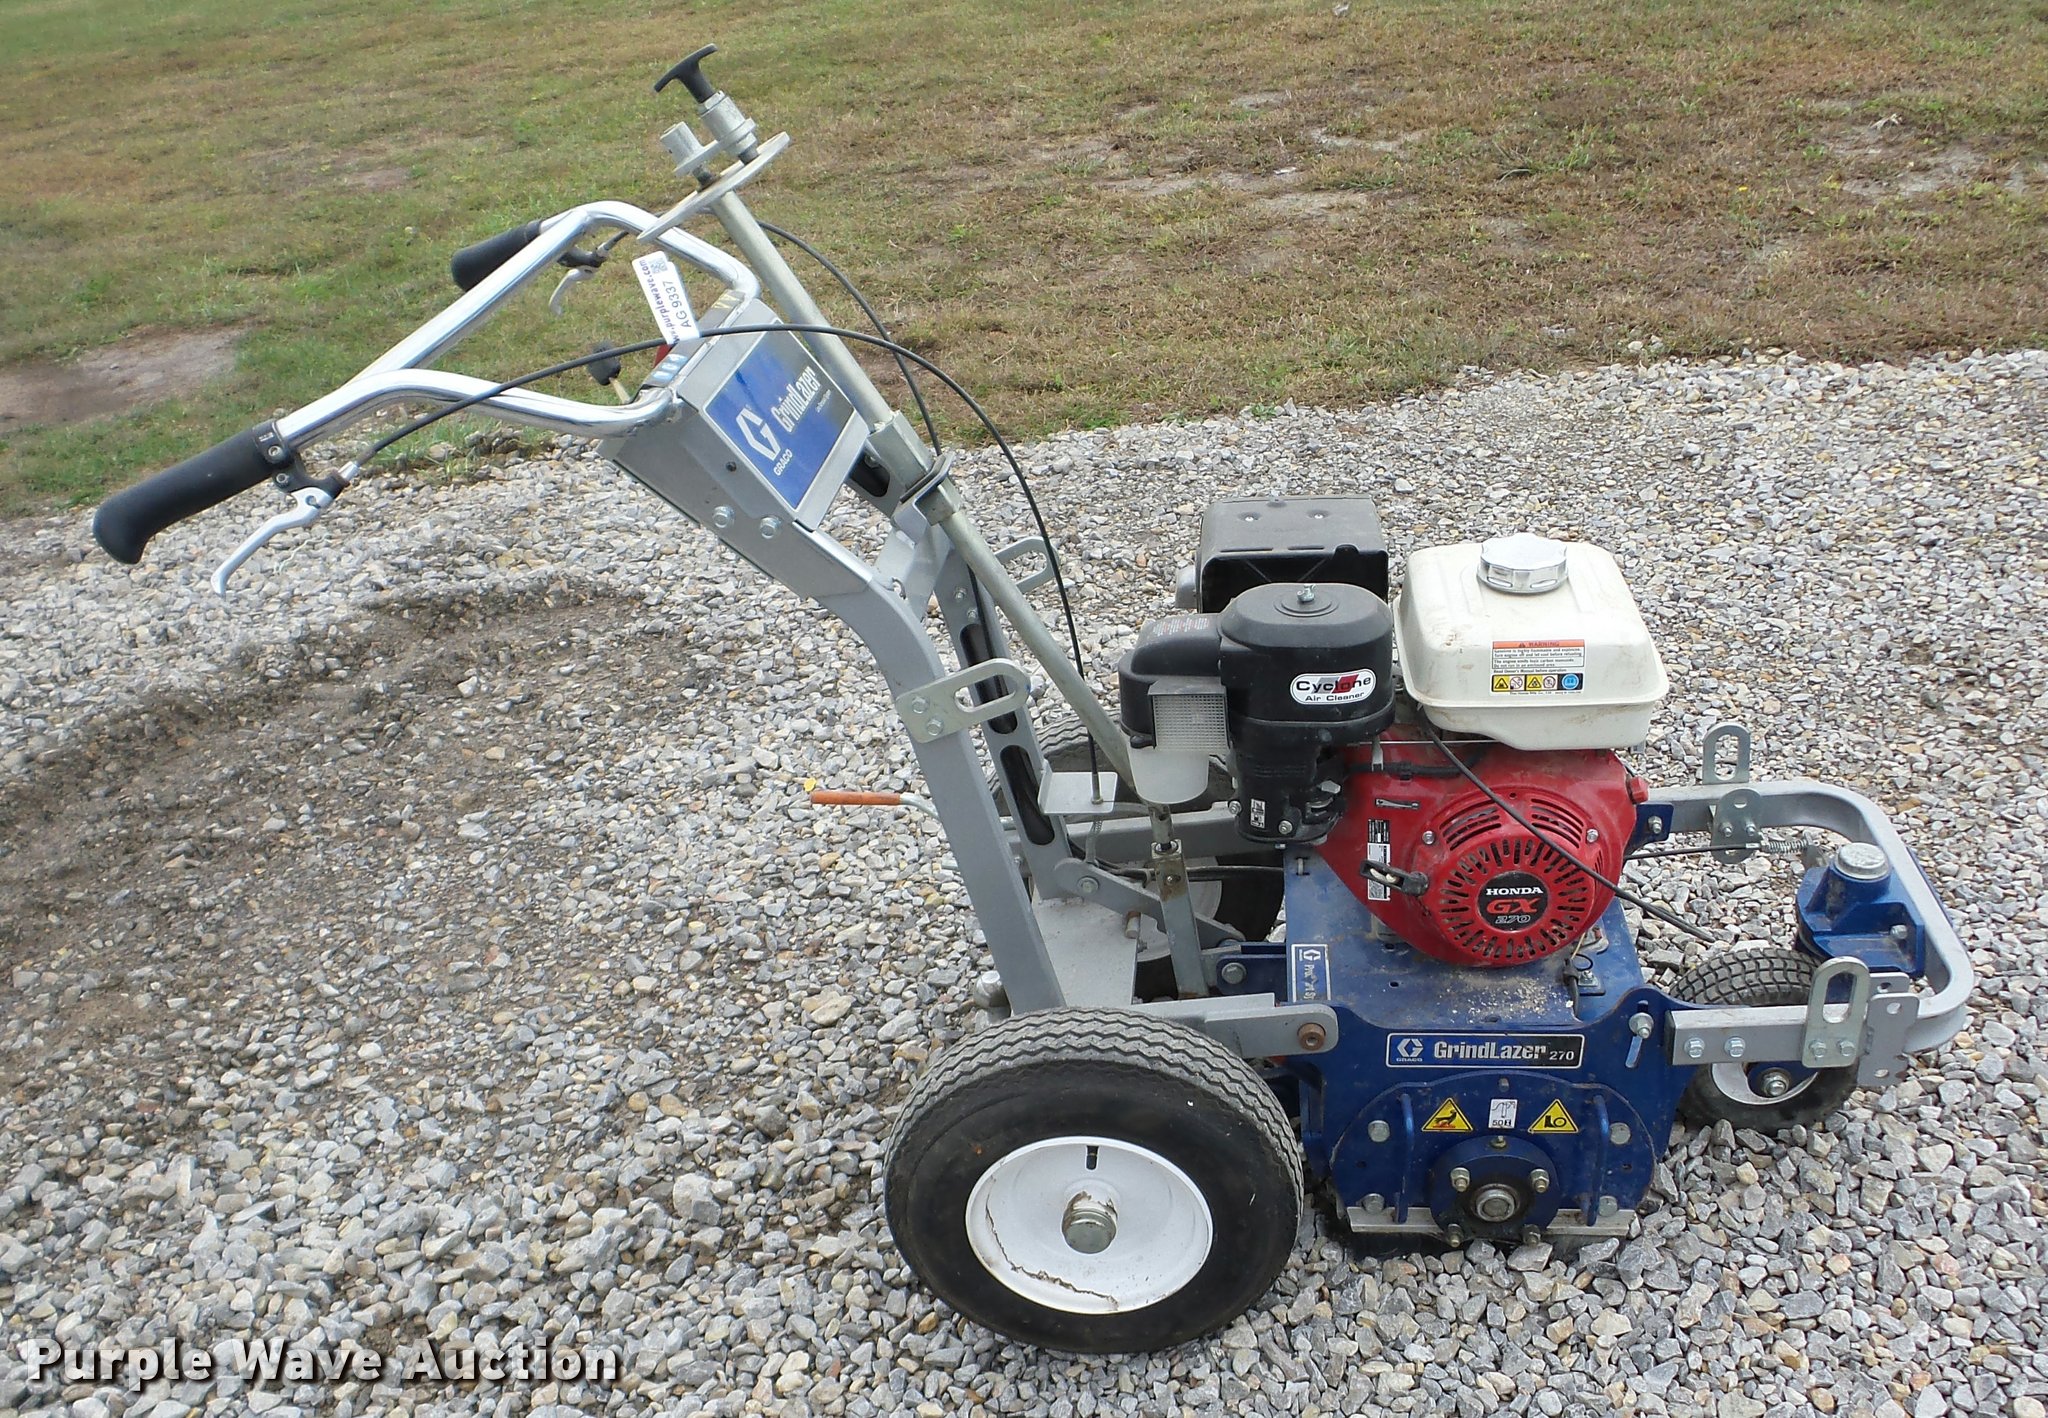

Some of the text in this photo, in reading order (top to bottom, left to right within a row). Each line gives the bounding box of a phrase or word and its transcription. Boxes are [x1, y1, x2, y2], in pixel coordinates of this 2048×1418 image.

[663, 281, 692, 328] AG 9337
[771, 366, 821, 432] GrindLazer
[773, 449, 793, 476] GRACO
[1296, 677, 1371, 693] Cyclone
[1326, 692, 1364, 701] Cleaner
[1486, 887, 1544, 895] HONDA
[1486, 897, 1542, 914] GX
[1495, 914, 1531, 924] 270
[1434, 1041, 1575, 1061] GrindLazer 270
